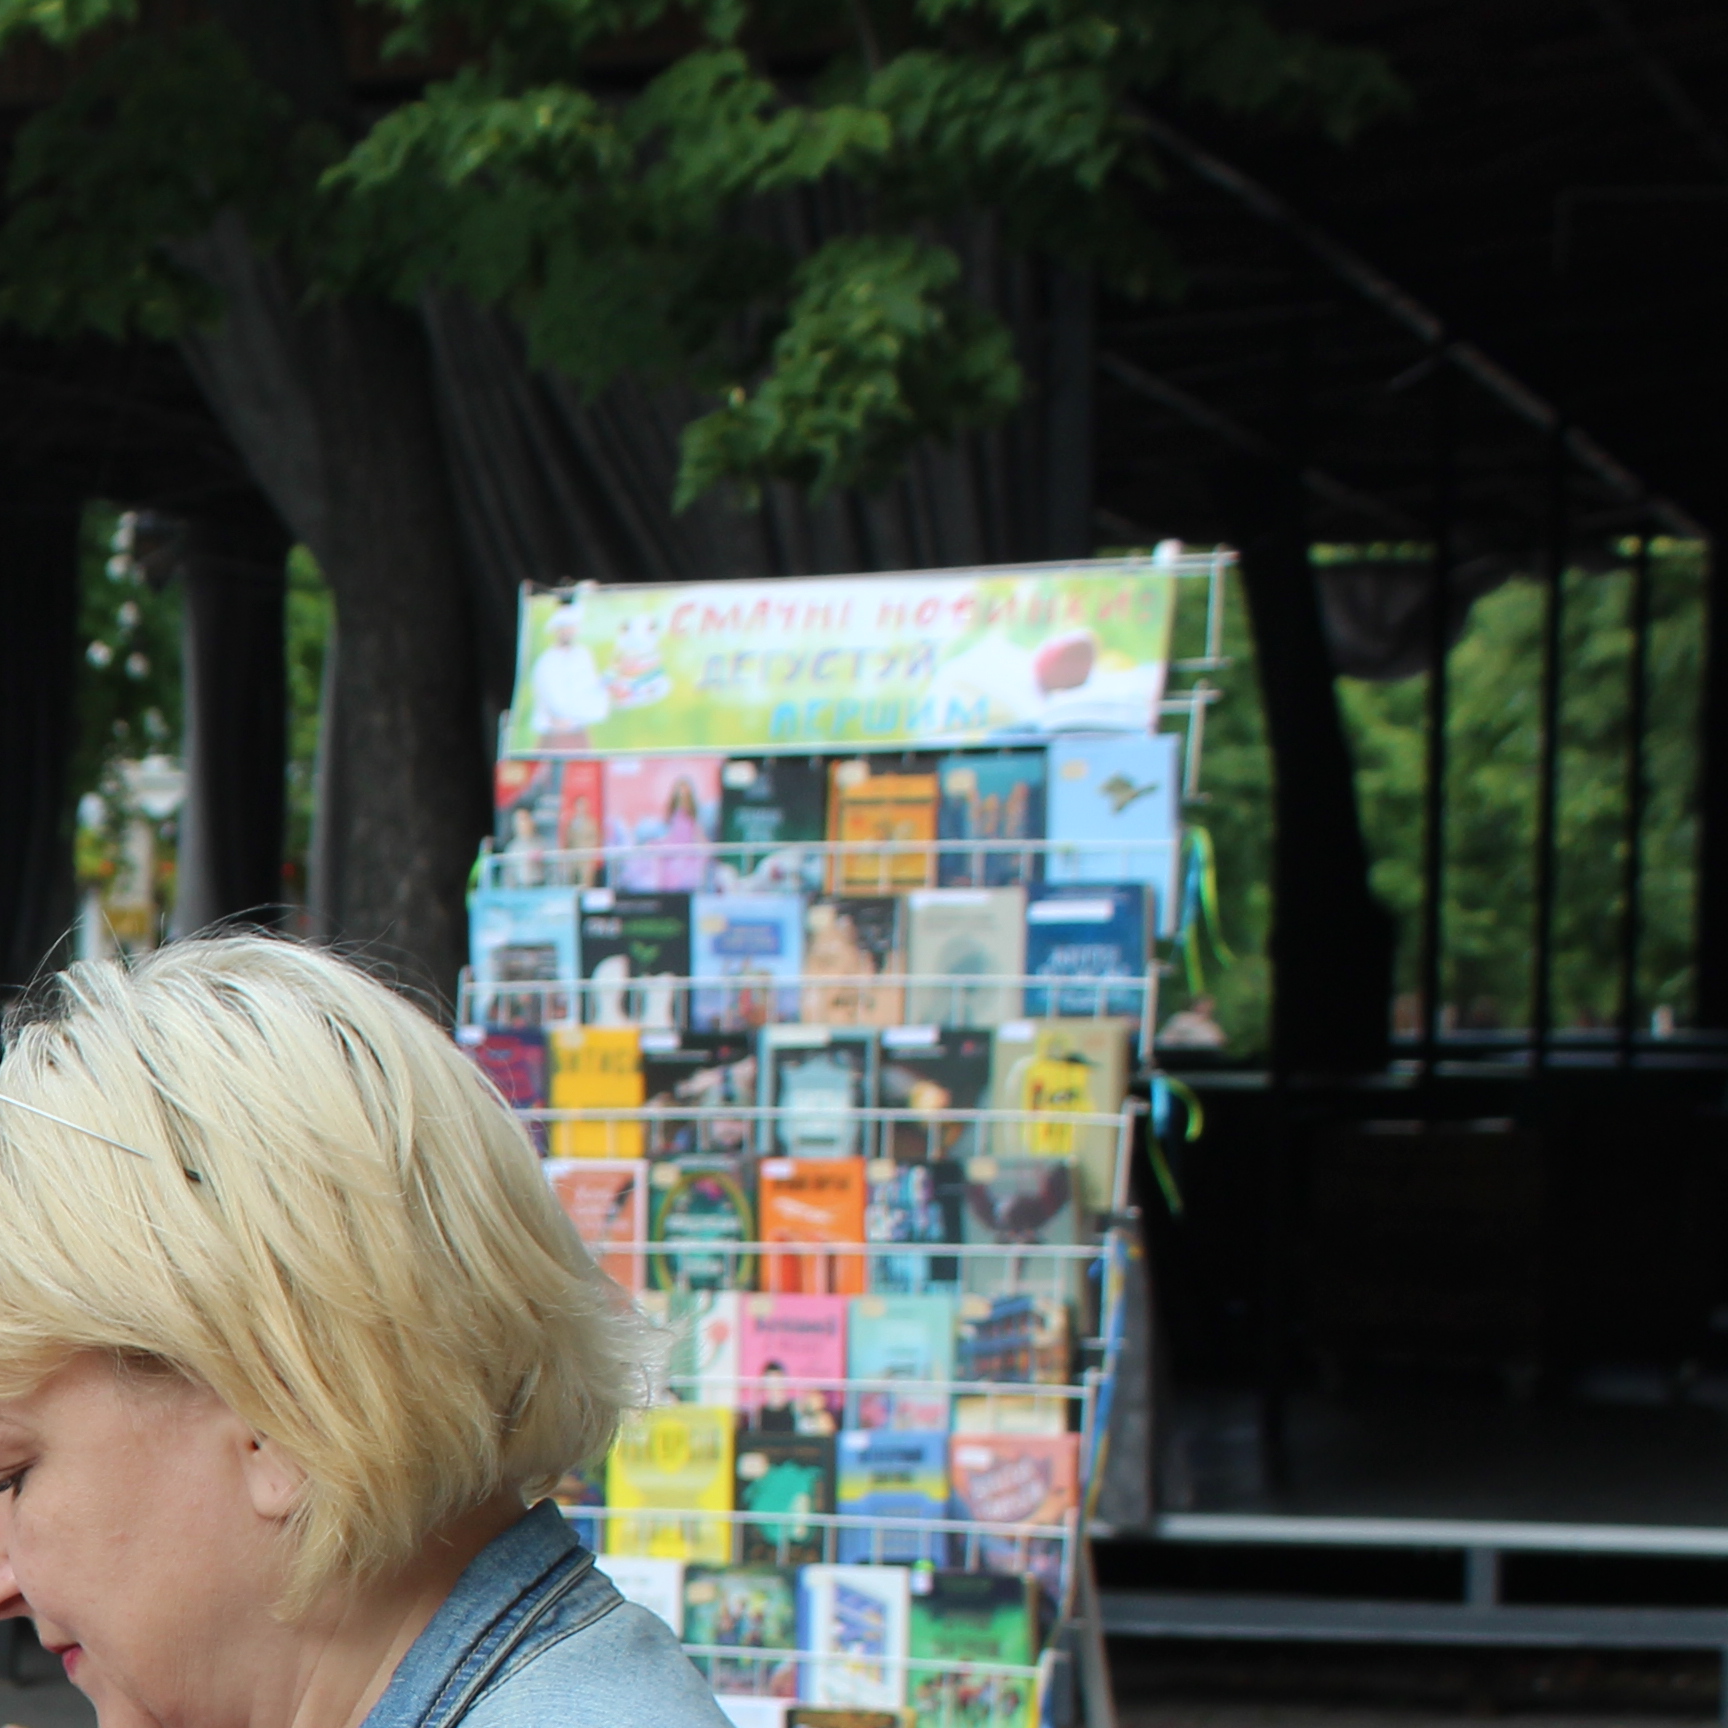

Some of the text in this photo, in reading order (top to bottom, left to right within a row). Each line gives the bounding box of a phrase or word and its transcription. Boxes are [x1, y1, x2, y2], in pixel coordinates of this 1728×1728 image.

[670, 593, 848, 638] СМАЧНІ
[697, 640, 938, 691] ДЕГУСТУЙ
[769, 696, 991, 739] ПЕРШИМ
